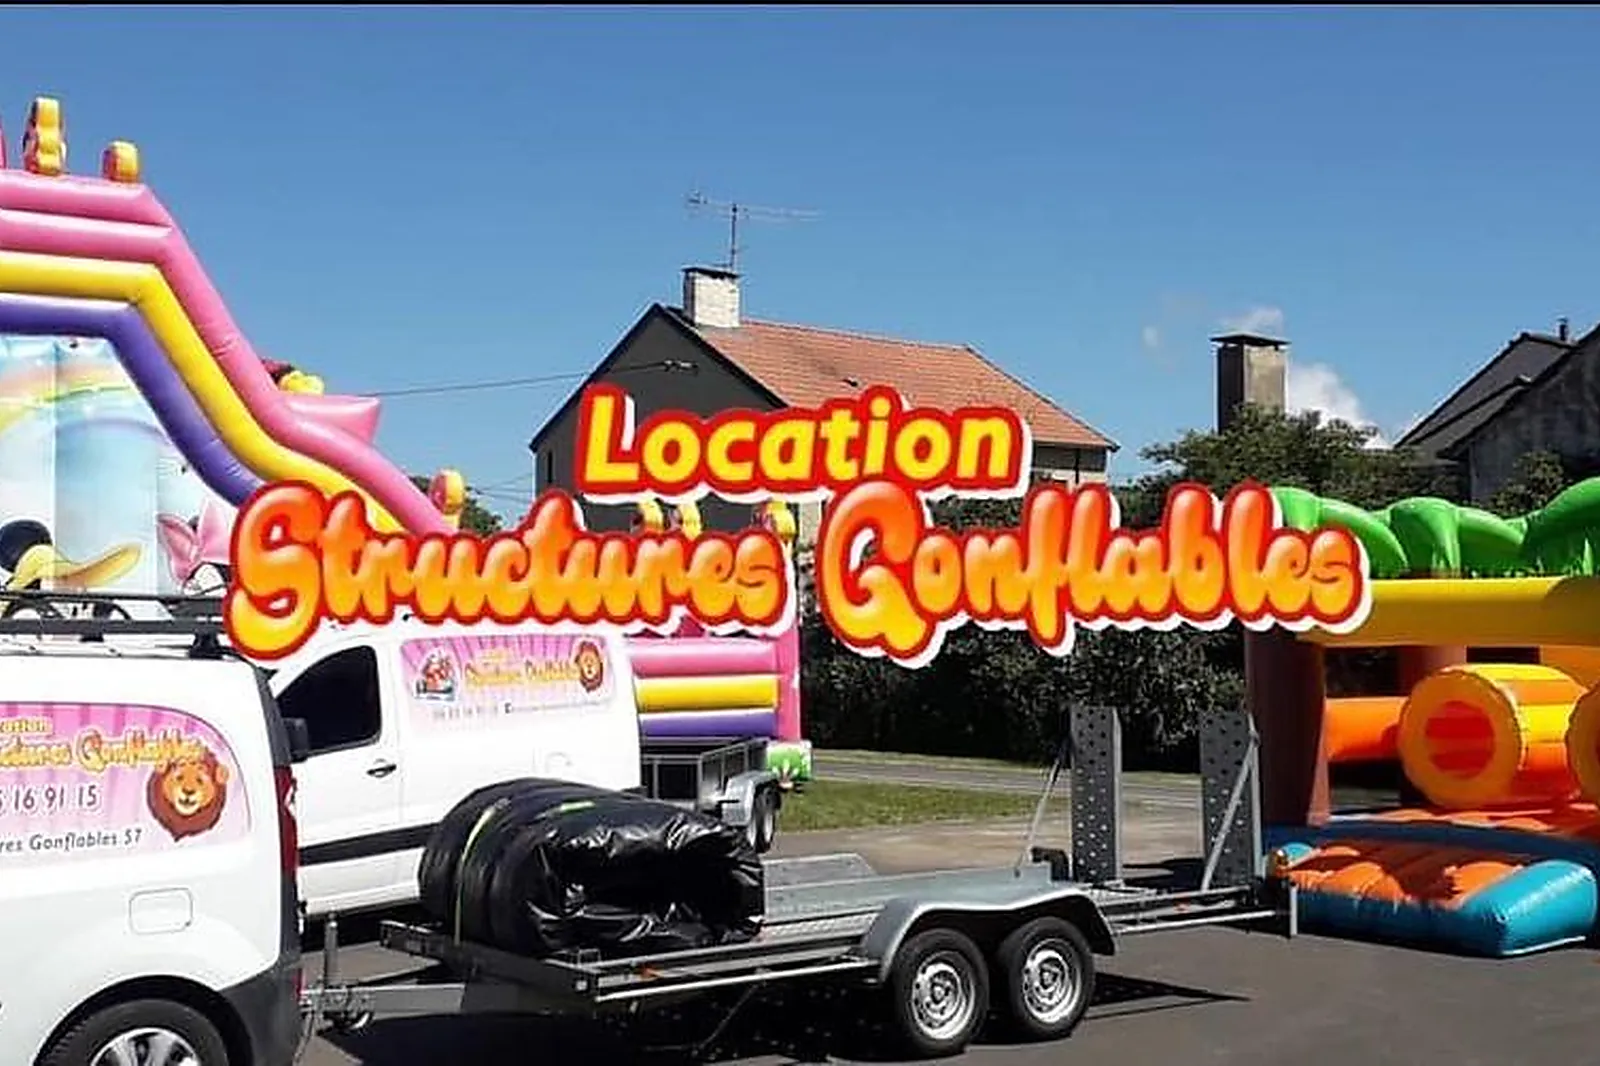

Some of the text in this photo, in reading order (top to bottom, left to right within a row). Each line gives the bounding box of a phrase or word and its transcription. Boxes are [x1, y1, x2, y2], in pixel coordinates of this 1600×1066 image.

[14, 788, 35, 810] 16
[45, 786, 64, 808] 91
[78, 784, 97, 807] 15
[29, 831, 117, 852] Gonflables
